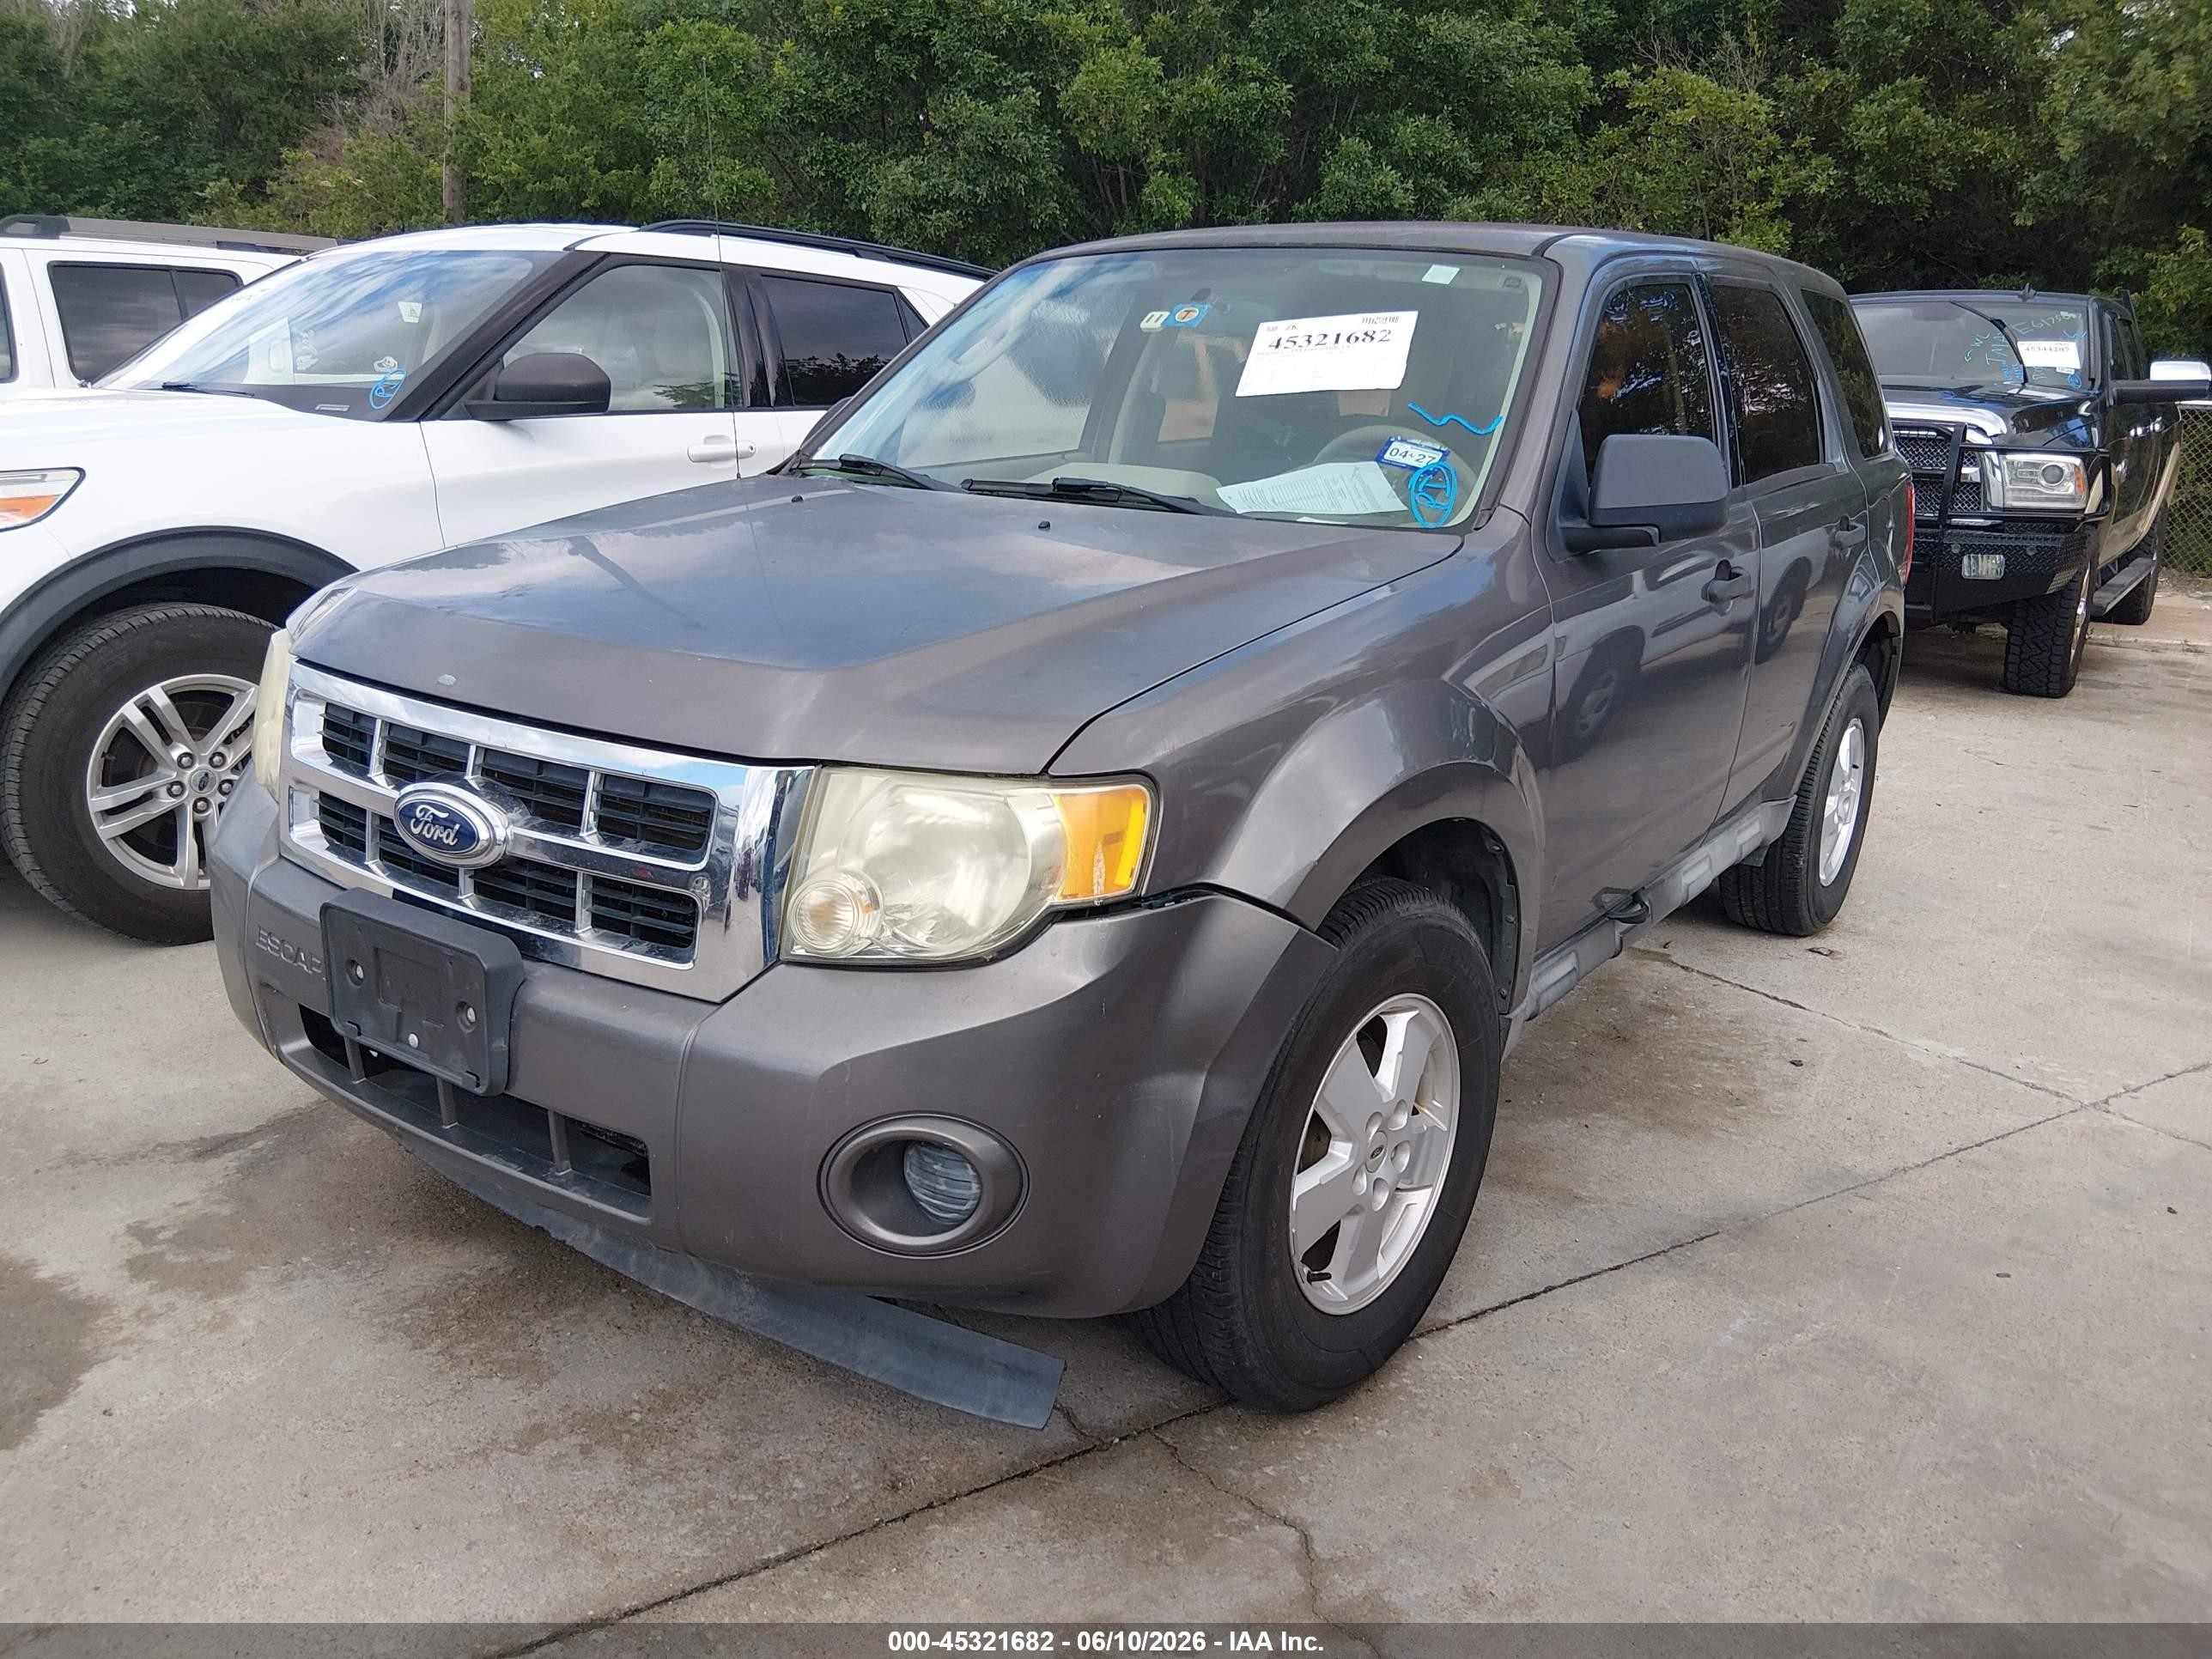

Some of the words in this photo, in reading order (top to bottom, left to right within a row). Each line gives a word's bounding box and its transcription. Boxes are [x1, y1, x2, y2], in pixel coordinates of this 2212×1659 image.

[1268, 329, 1393, 350] 45321682
[410, 804, 461, 847] Ford
[254, 925, 325, 980] ESCAP
